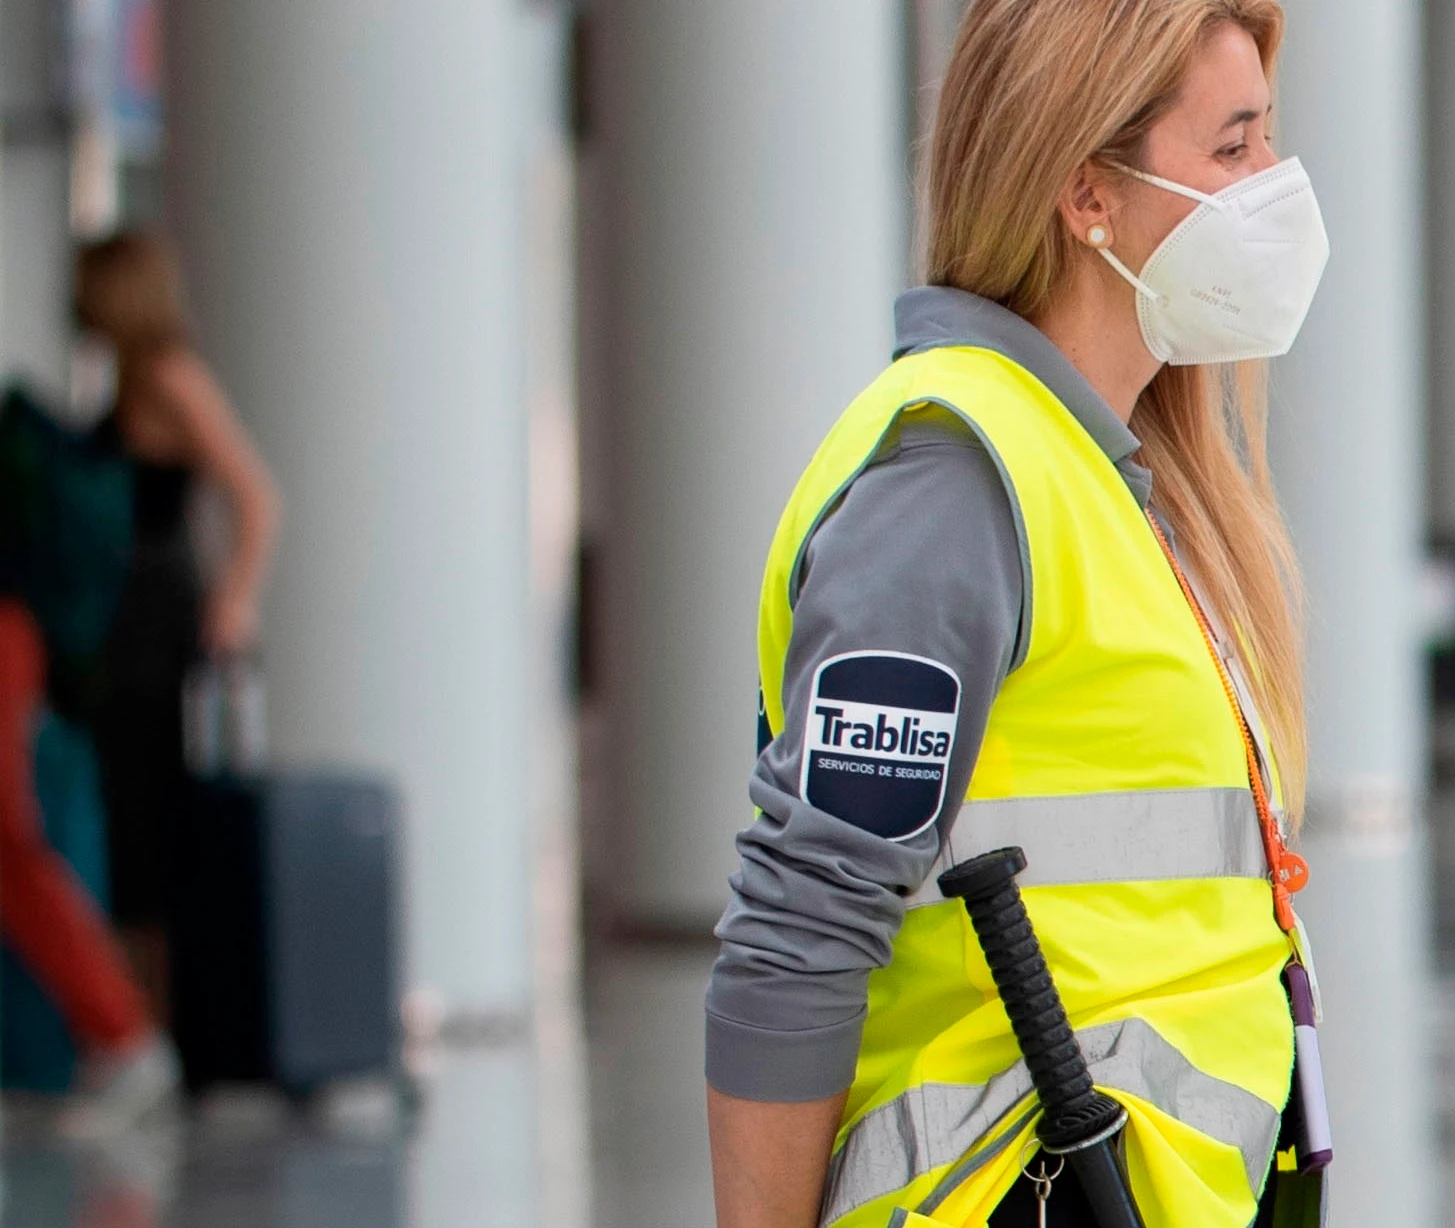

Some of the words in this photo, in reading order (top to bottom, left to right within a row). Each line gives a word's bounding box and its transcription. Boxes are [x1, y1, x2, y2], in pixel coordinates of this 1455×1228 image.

[815, 705, 951, 758] Trablisa
[818, 757, 875, 776] SERVICIOS
[879, 765, 893, 778] DE
[895, 767, 942, 781] SEGURIDAD
